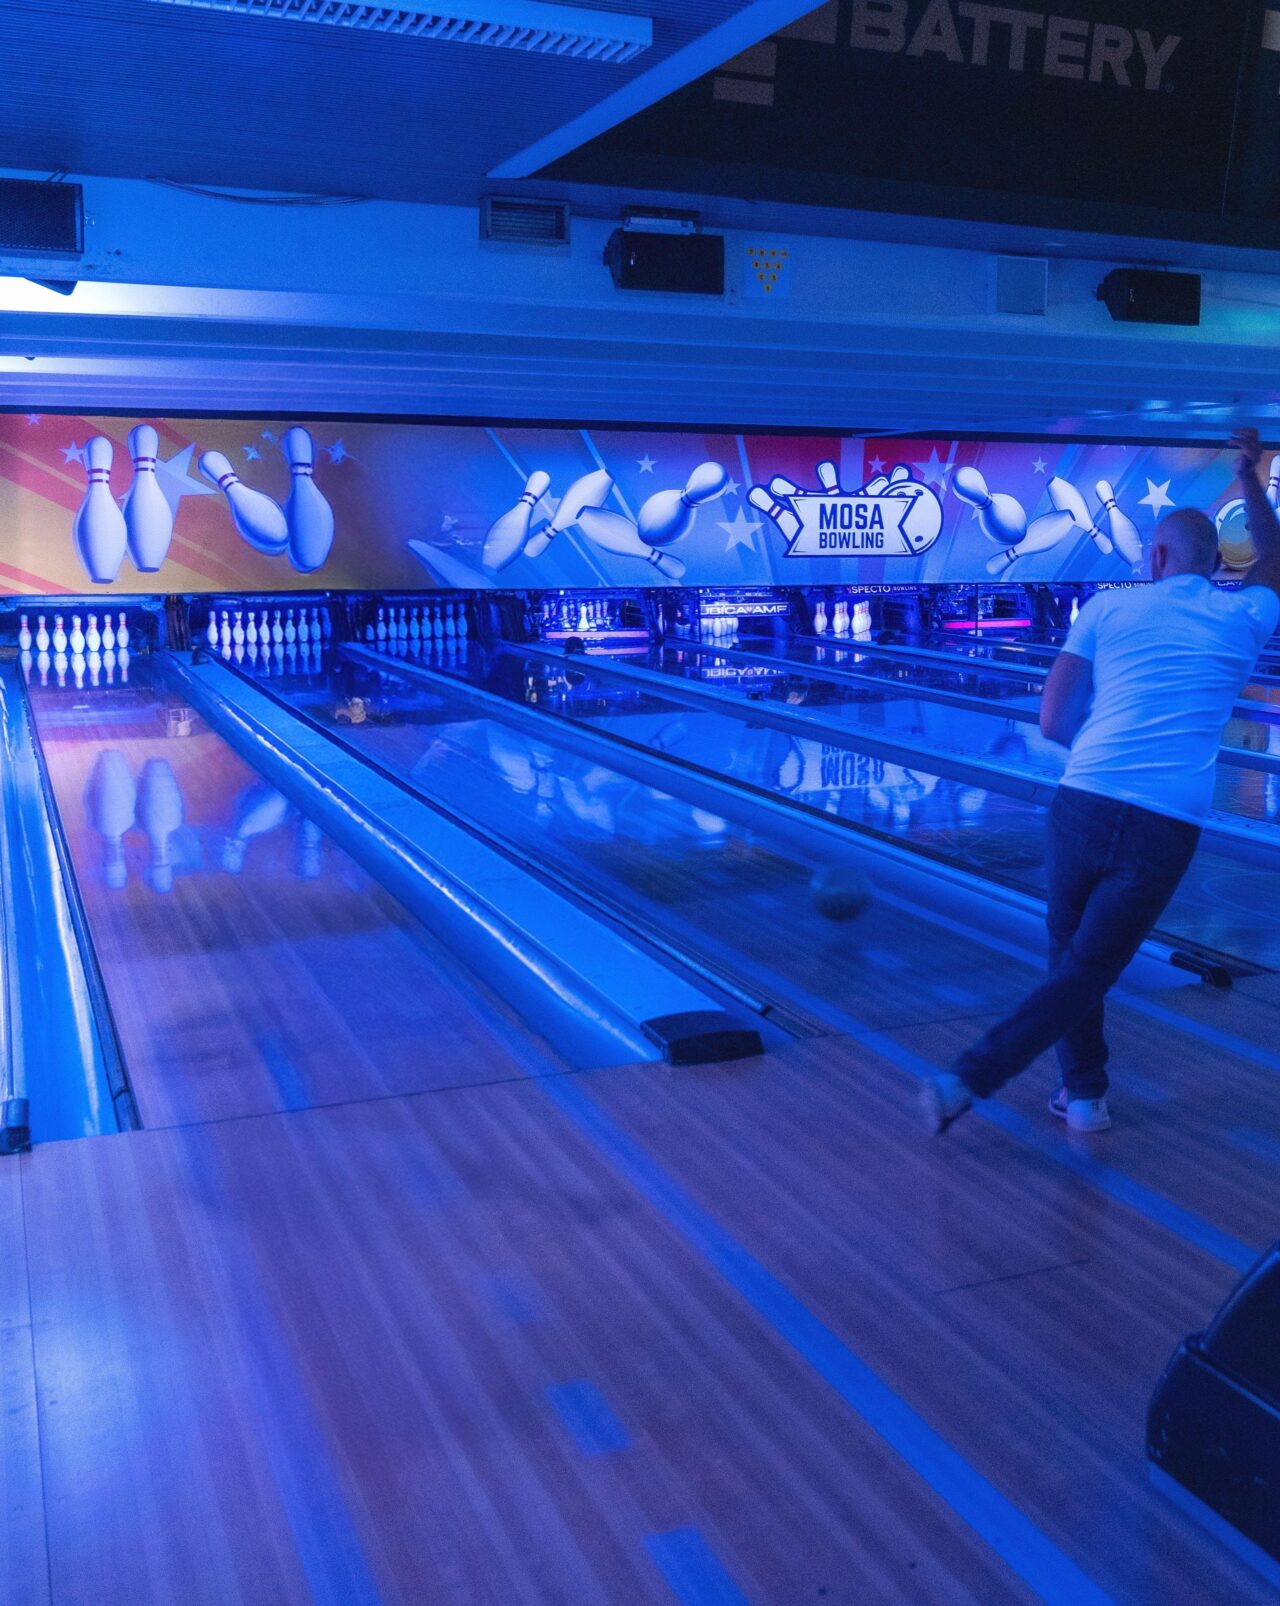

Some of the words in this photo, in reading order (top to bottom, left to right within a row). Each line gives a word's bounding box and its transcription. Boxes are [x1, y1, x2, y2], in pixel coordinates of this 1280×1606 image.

[849, 0, 1182, 91] BATTERY
[819, 503, 884, 530] MOSA
[819, 532, 884, 549] BOWLING
[851, 585, 891, 594] SPECTO
